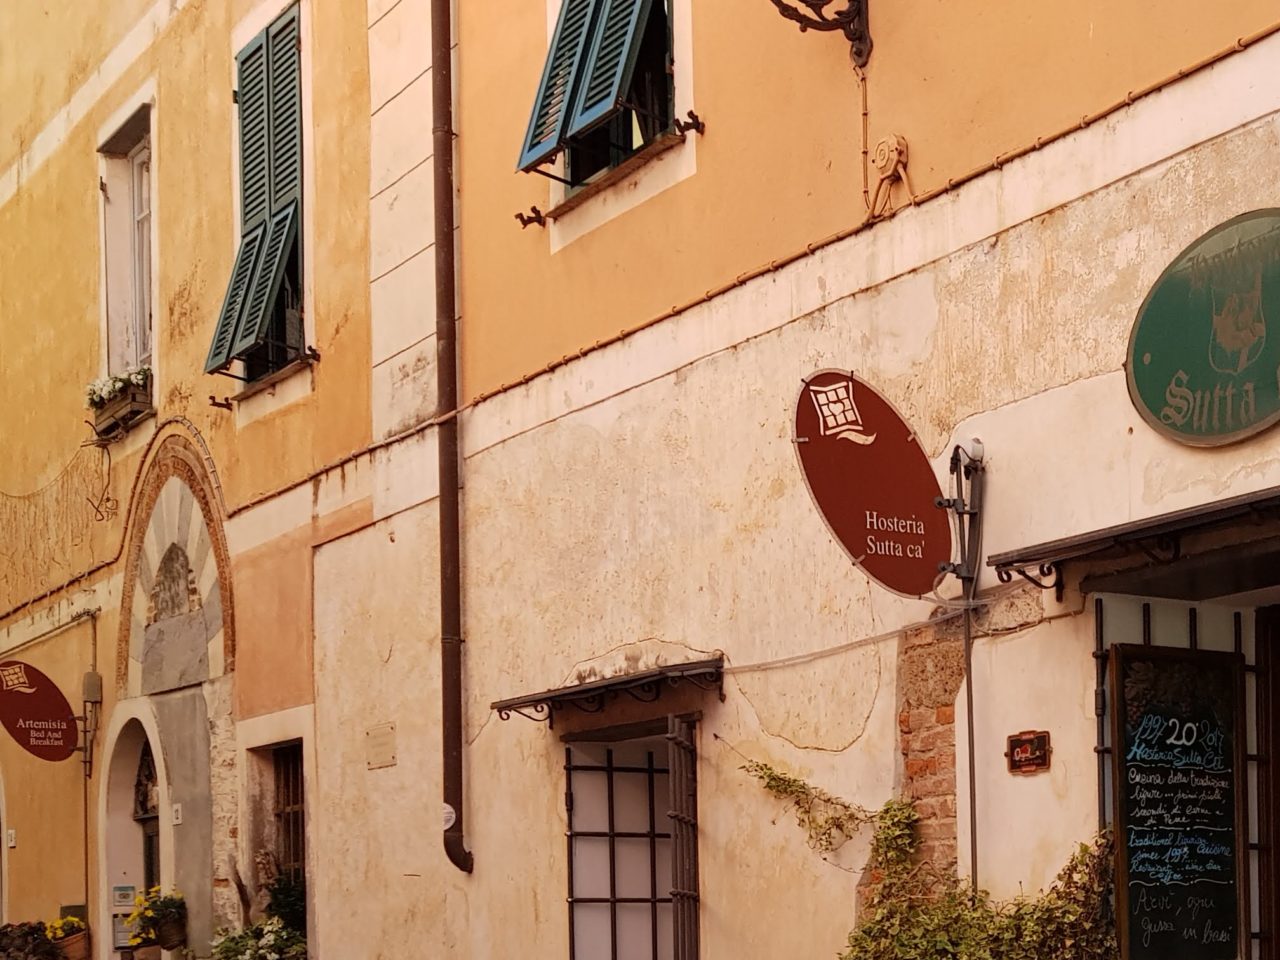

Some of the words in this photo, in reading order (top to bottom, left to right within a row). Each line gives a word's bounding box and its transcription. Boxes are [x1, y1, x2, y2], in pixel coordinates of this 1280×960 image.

[1160, 369, 1256, 432] Sutta
[865, 511, 925, 535] Hosteria
[866, 535, 903, 556] Sutta
[16, 718, 67, 729] Artemisia
[30, 738, 63, 746] Breakfast
